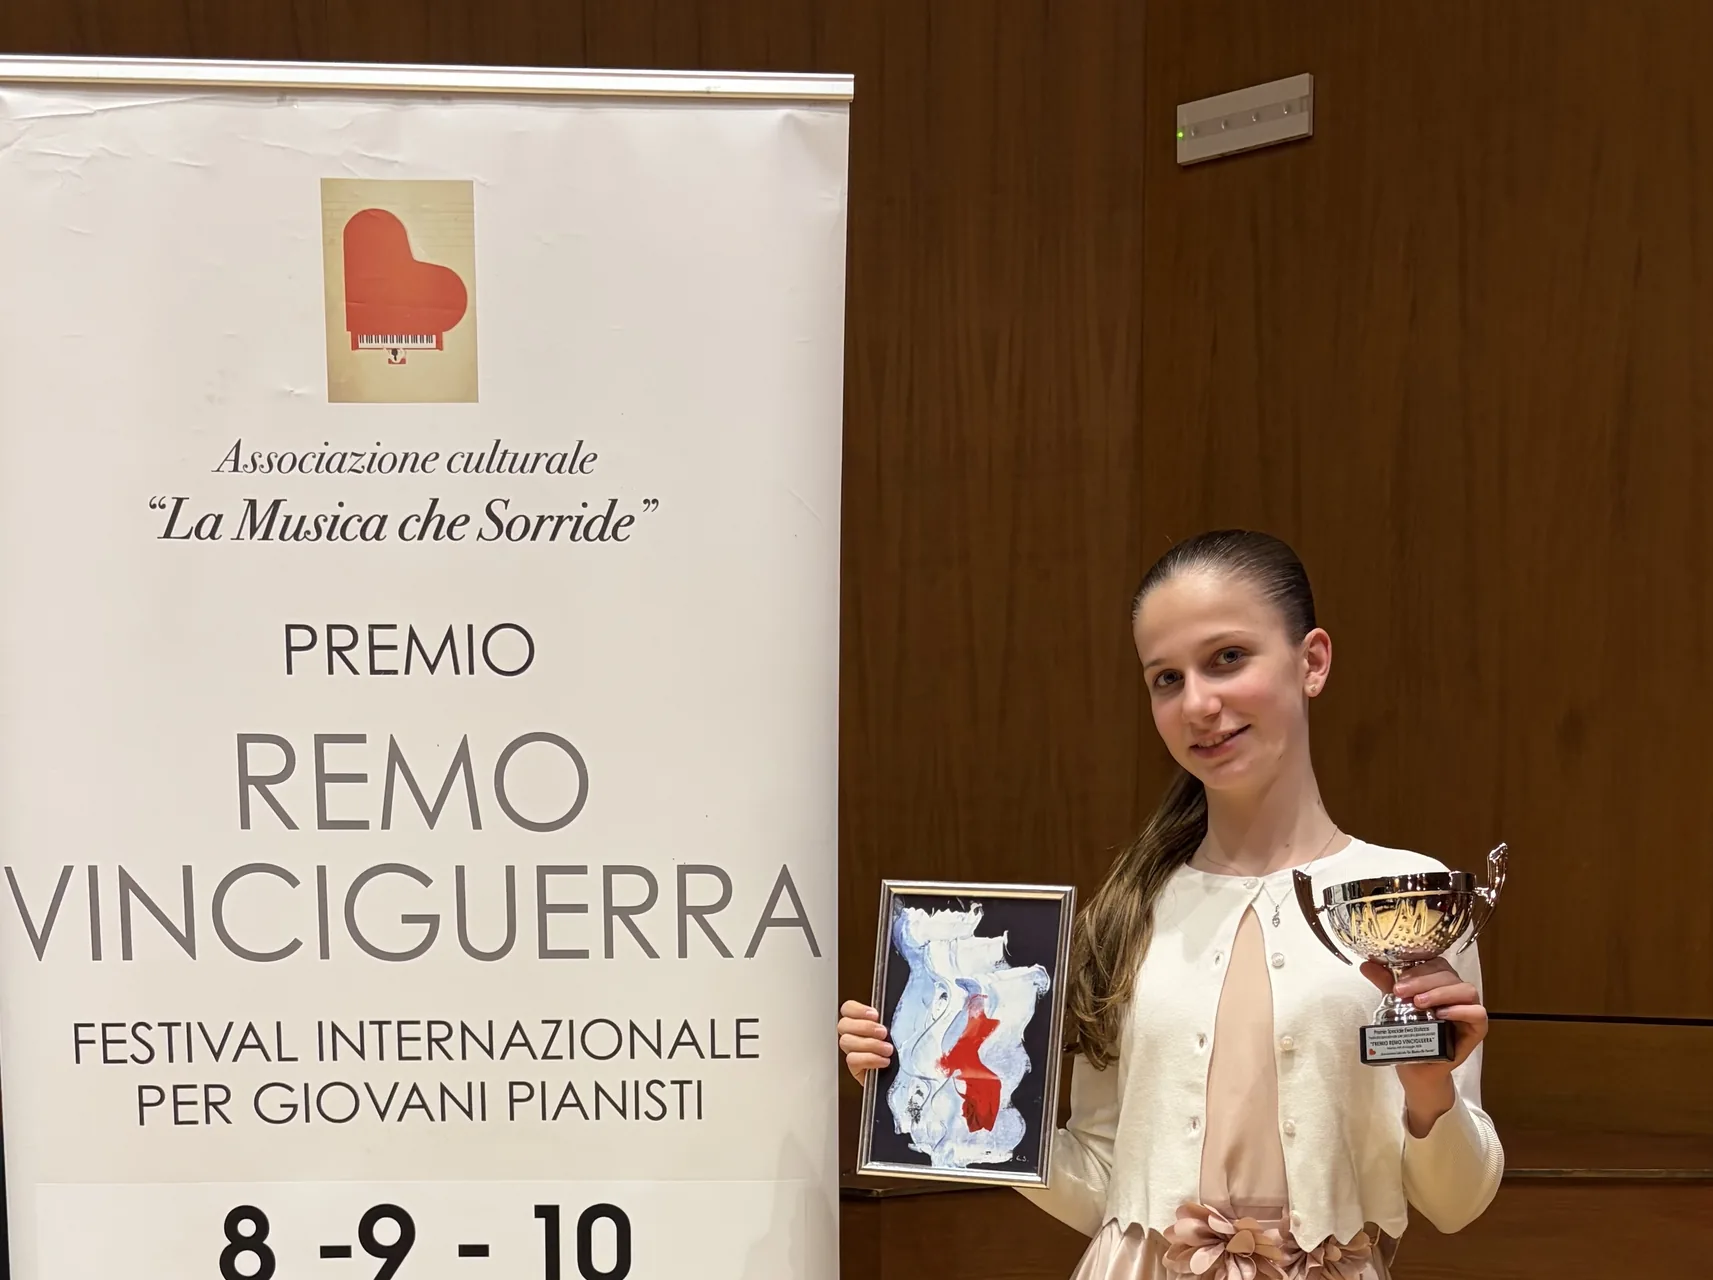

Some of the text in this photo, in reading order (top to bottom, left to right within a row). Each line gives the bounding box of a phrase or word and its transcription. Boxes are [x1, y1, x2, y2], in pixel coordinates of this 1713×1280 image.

[212, 438, 598, 475] Associazione culturale
[231, 499, 386, 542] Musica
[398, 499, 467, 542] che
[285, 622, 536, 677] PREMIO
[236, 731, 590, 832] REMO
[4, 862, 823, 962] VINCIGUERRA
[73, 1018, 761, 1065] FESTIVAL INTERNAZIONALE
[137, 1080, 704, 1126] PER GIOVANI PIANISTI
